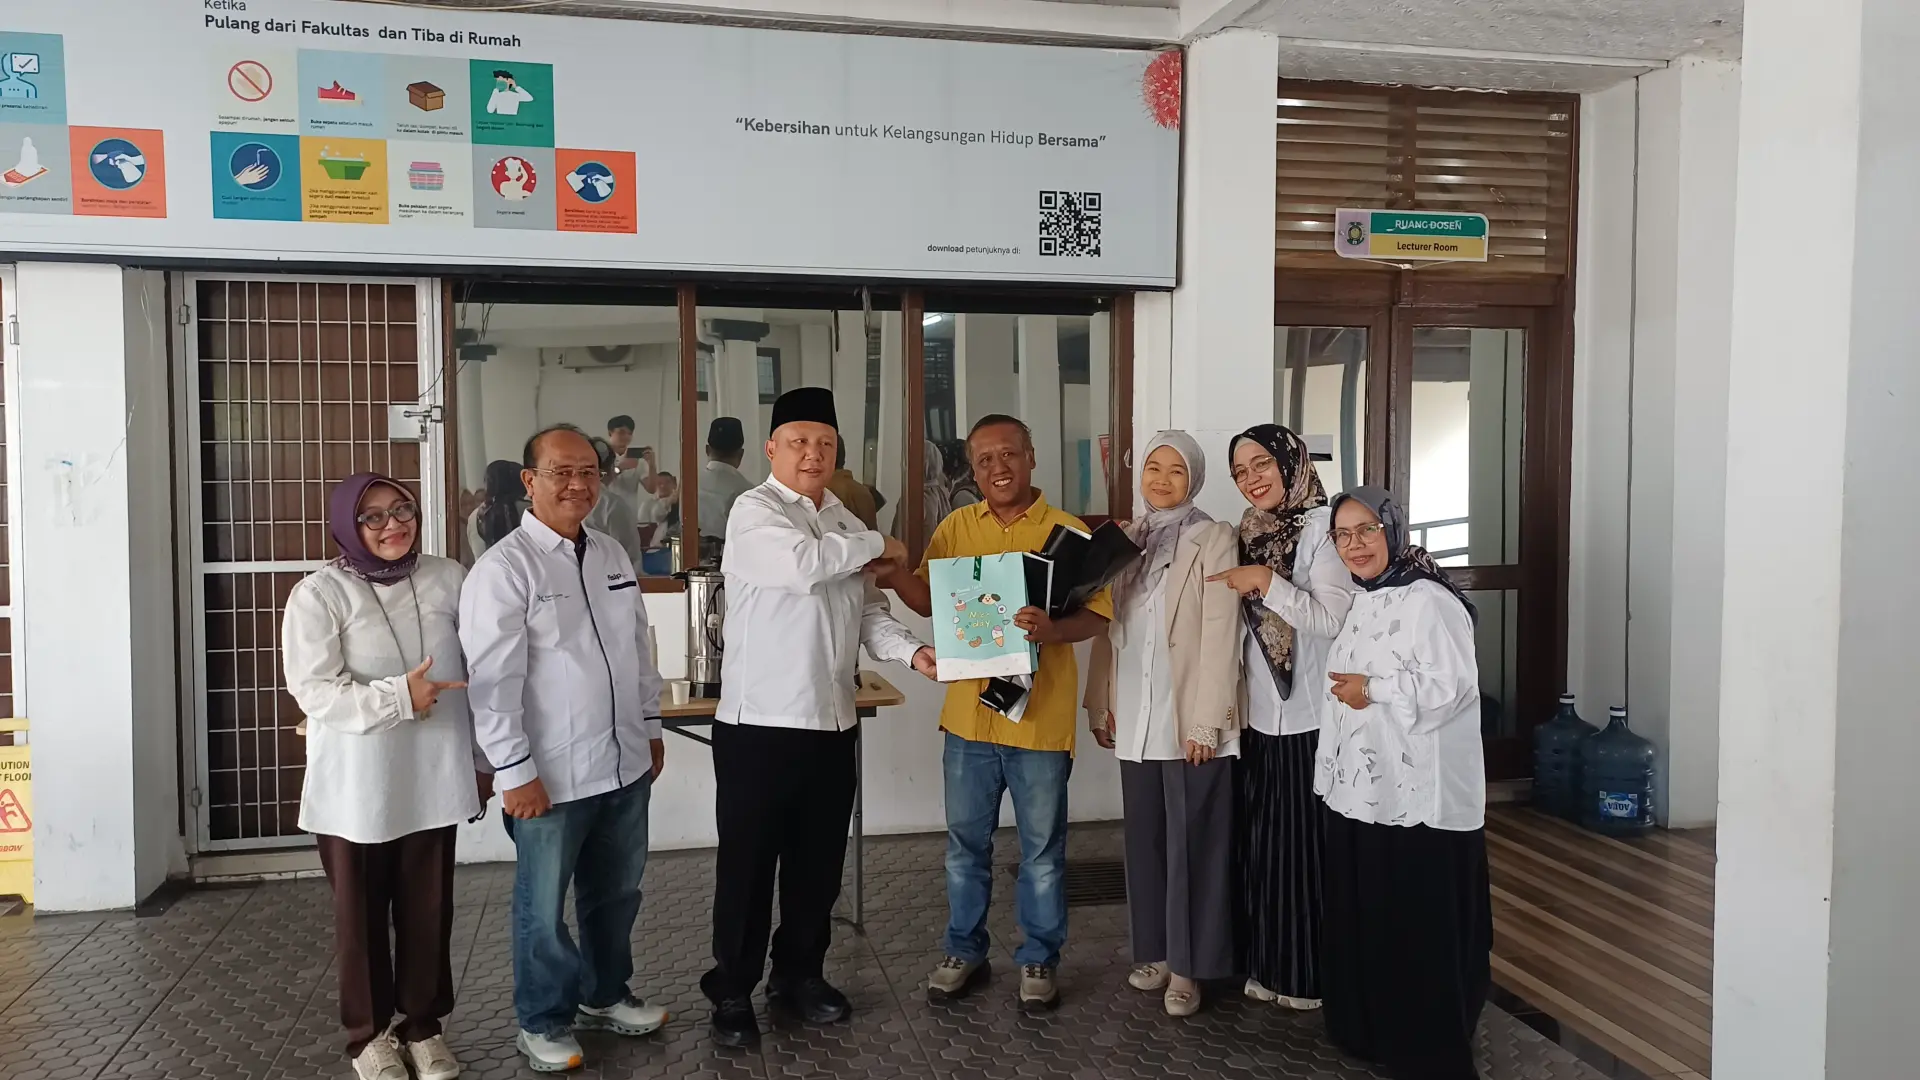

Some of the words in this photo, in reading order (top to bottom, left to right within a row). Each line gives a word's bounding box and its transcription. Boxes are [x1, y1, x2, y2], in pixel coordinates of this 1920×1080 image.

[204, 0, 247, 11] Ketika
[205, 14, 260, 34] Pulang
[264, 18, 296, 32] dari
[302, 20, 370, 38] Fakultas
[378, 26, 407, 40] dan
[411, 28, 445, 42] Tiba
[450, 31, 463, 44] di
[468, 32, 521, 47] Rumah
[736, 118, 830, 135] “Kebersihan
[835, 124, 878, 138] untuk
[883, 124, 986, 145] Kelangsungan
[990, 130, 1034, 148] Hidup
[1038, 132, 1106, 148] Bersama”
[1395, 220, 1428, 229] RUANG
[1430, 220, 1462, 230] DOSEN
[927, 244, 964, 253] download
[966, 245, 1010, 256] petunjuknya
[1397, 242, 1432, 251] Lecturer
[1434, 243, 1458, 251] Room
[0, 761, 30, 770] UTION
